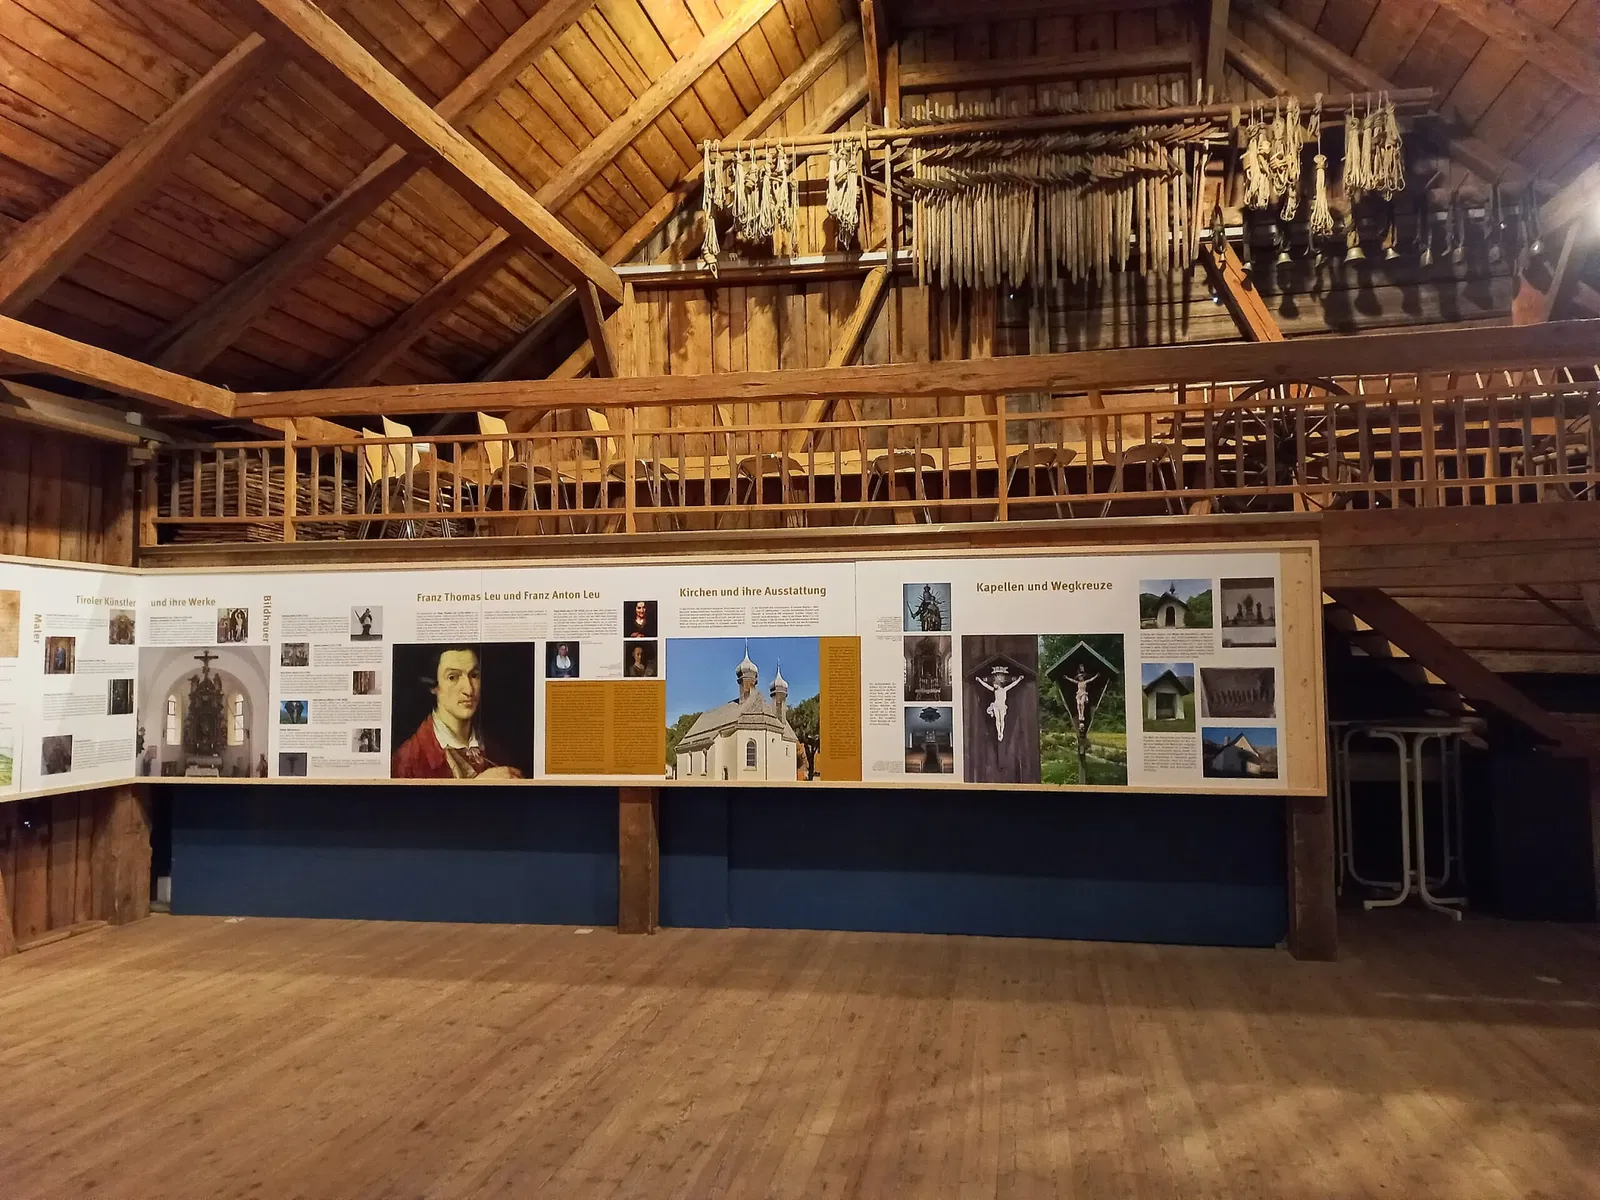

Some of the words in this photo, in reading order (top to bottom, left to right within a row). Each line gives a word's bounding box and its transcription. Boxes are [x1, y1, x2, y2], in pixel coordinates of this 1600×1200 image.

[679, 587, 718, 597] Kirchen
[720, 587, 739, 596] und
[742, 586, 762, 596] ihre
[764, 586, 826, 597] Ausstattung
[976, 582, 1024, 594] Kapellen
[1028, 581, 1048, 591] und
[1051, 581, 1113, 593] Wegkreuze
[76, 595, 102, 606] Tiroler
[104, 596, 136, 606] Künstler
[150, 598, 167, 607] und
[169, 598, 186, 606] ihre
[188, 596, 216, 606] Werke
[417, 593, 442, 602] Franz
[444, 592, 481, 602] Thomas
[484, 592, 500, 600] Leu
[504, 591, 521, 600] und
[524, 591, 550, 600] Franz
[552, 590, 580, 600] Anton
[584, 590, 600, 599] Leu
[262, 595, 272, 642] Bildhauer
[33, 614, 42, 644] Maler
